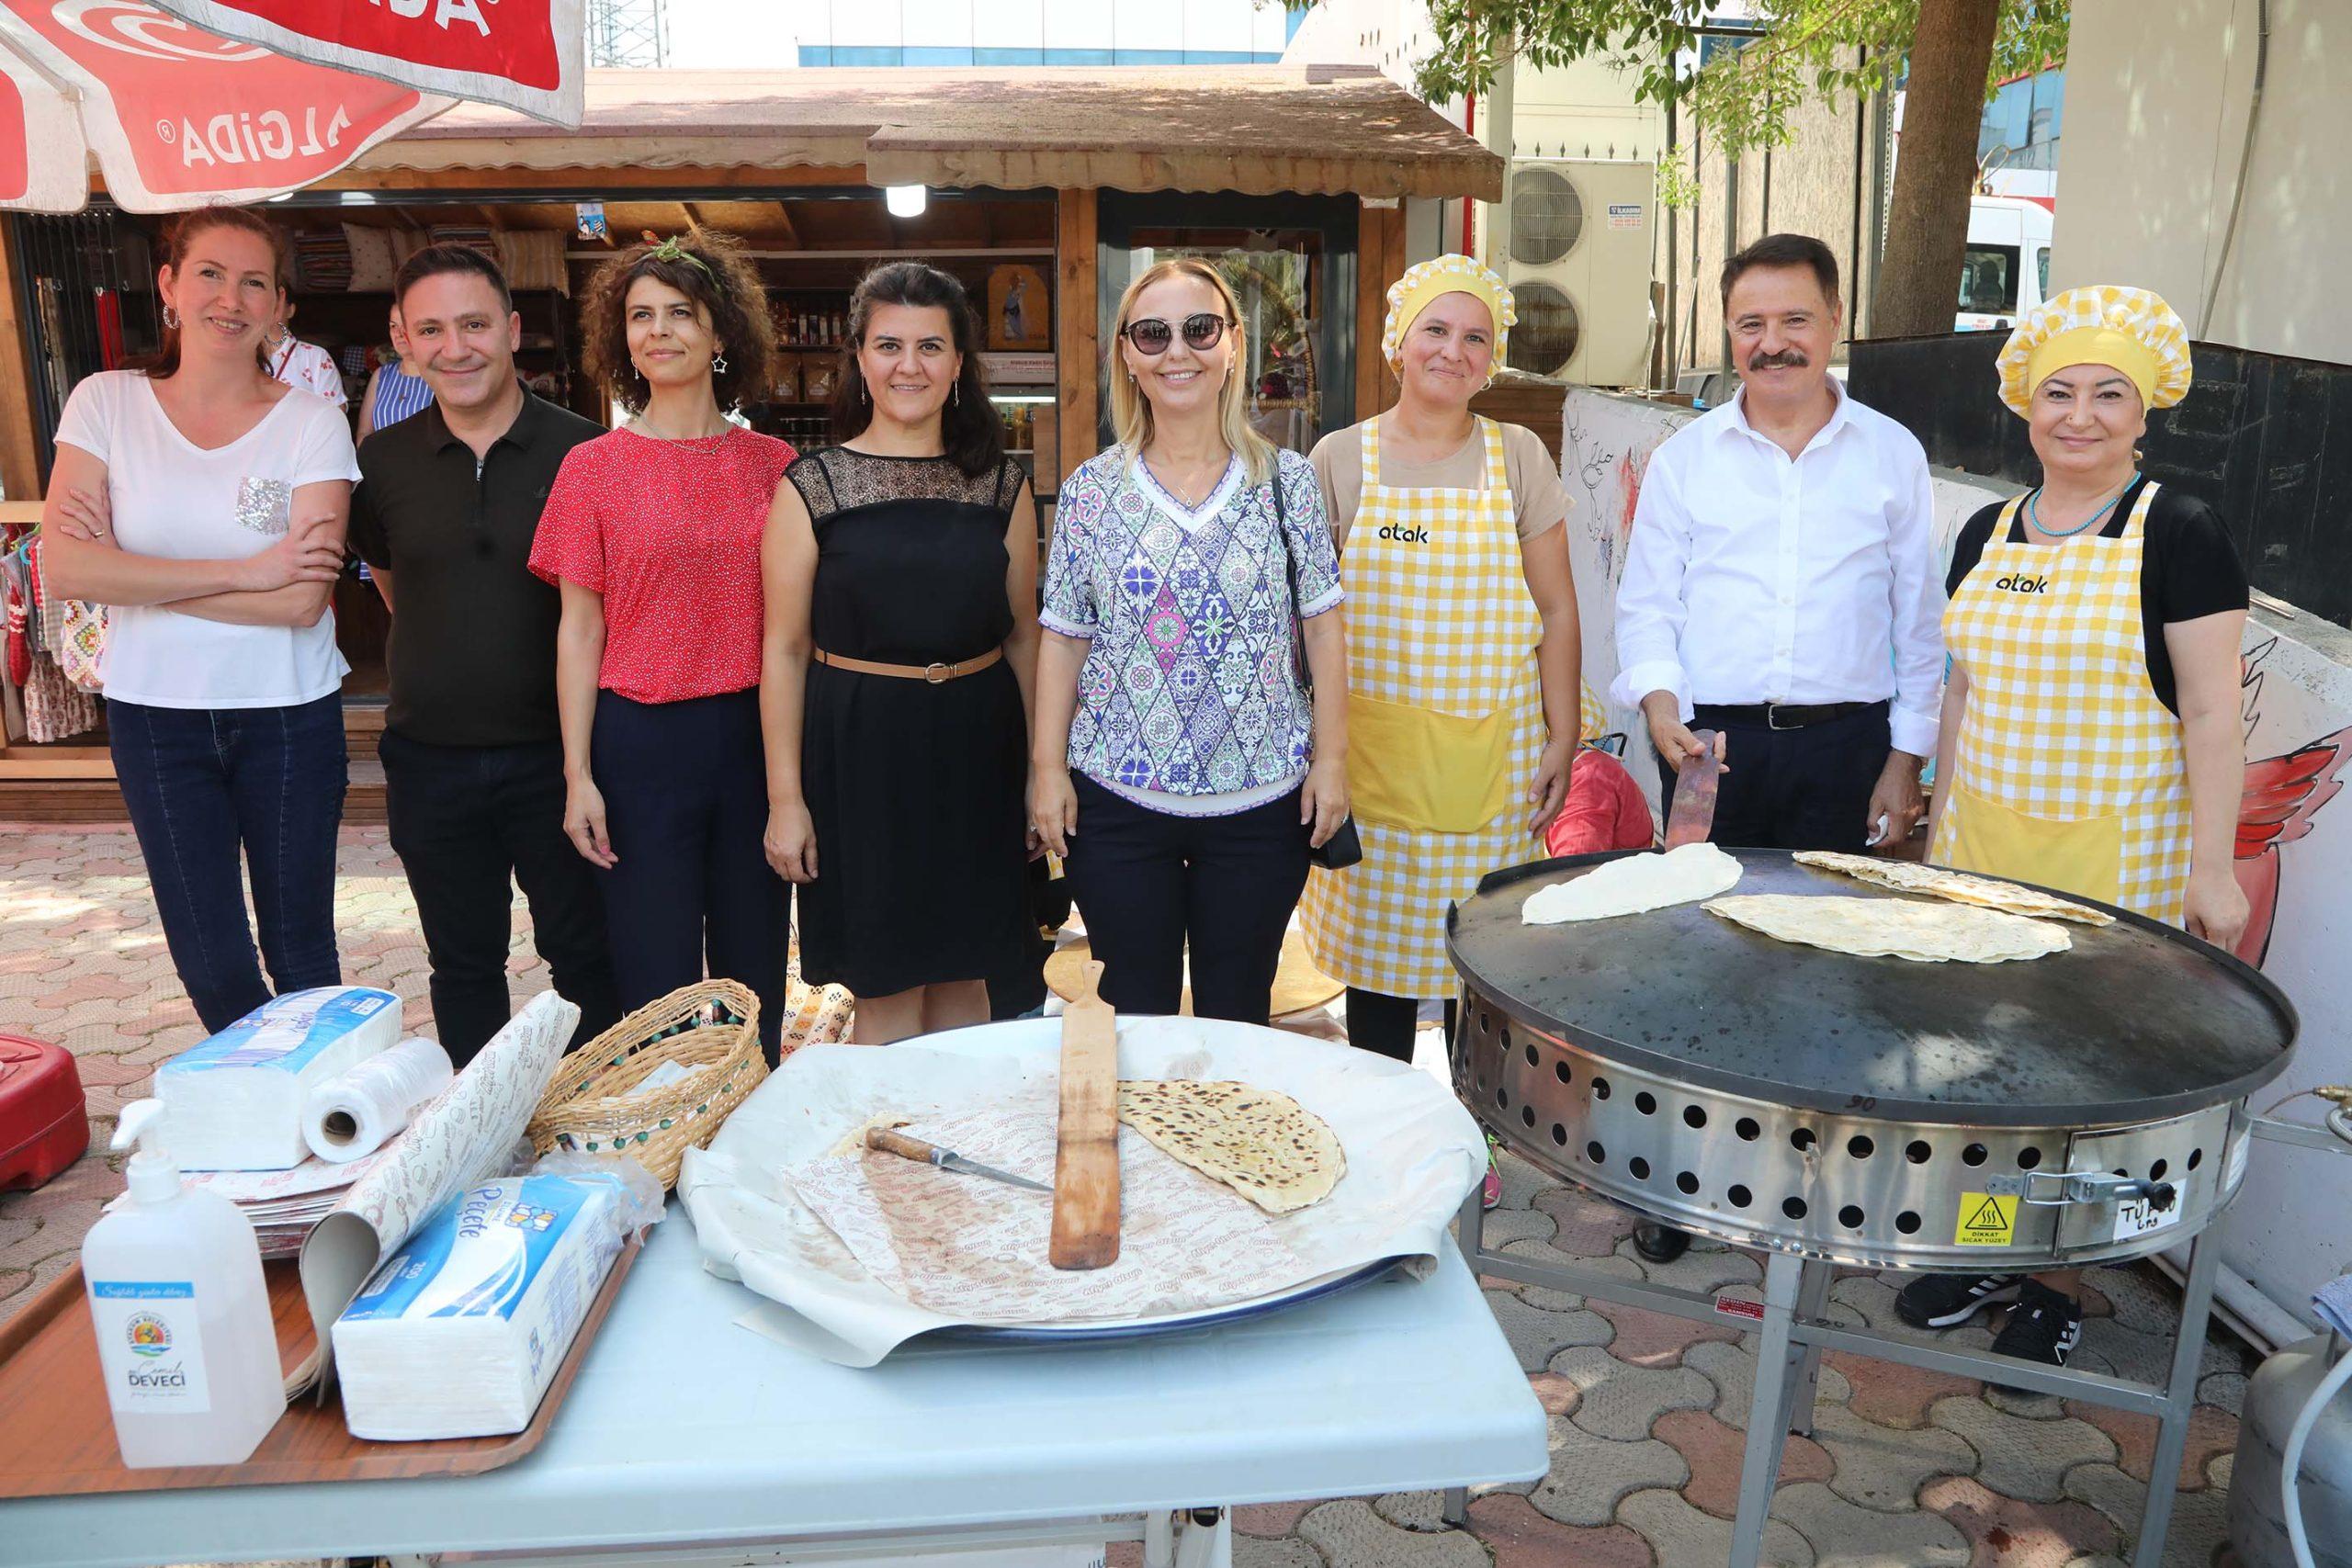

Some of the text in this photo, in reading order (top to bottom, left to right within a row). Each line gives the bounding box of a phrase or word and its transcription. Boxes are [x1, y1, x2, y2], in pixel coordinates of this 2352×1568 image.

[1379, 523, 1428, 544] atak
[1996, 573, 2048, 593] atak
[457, 1186, 503, 1238] Peçete
